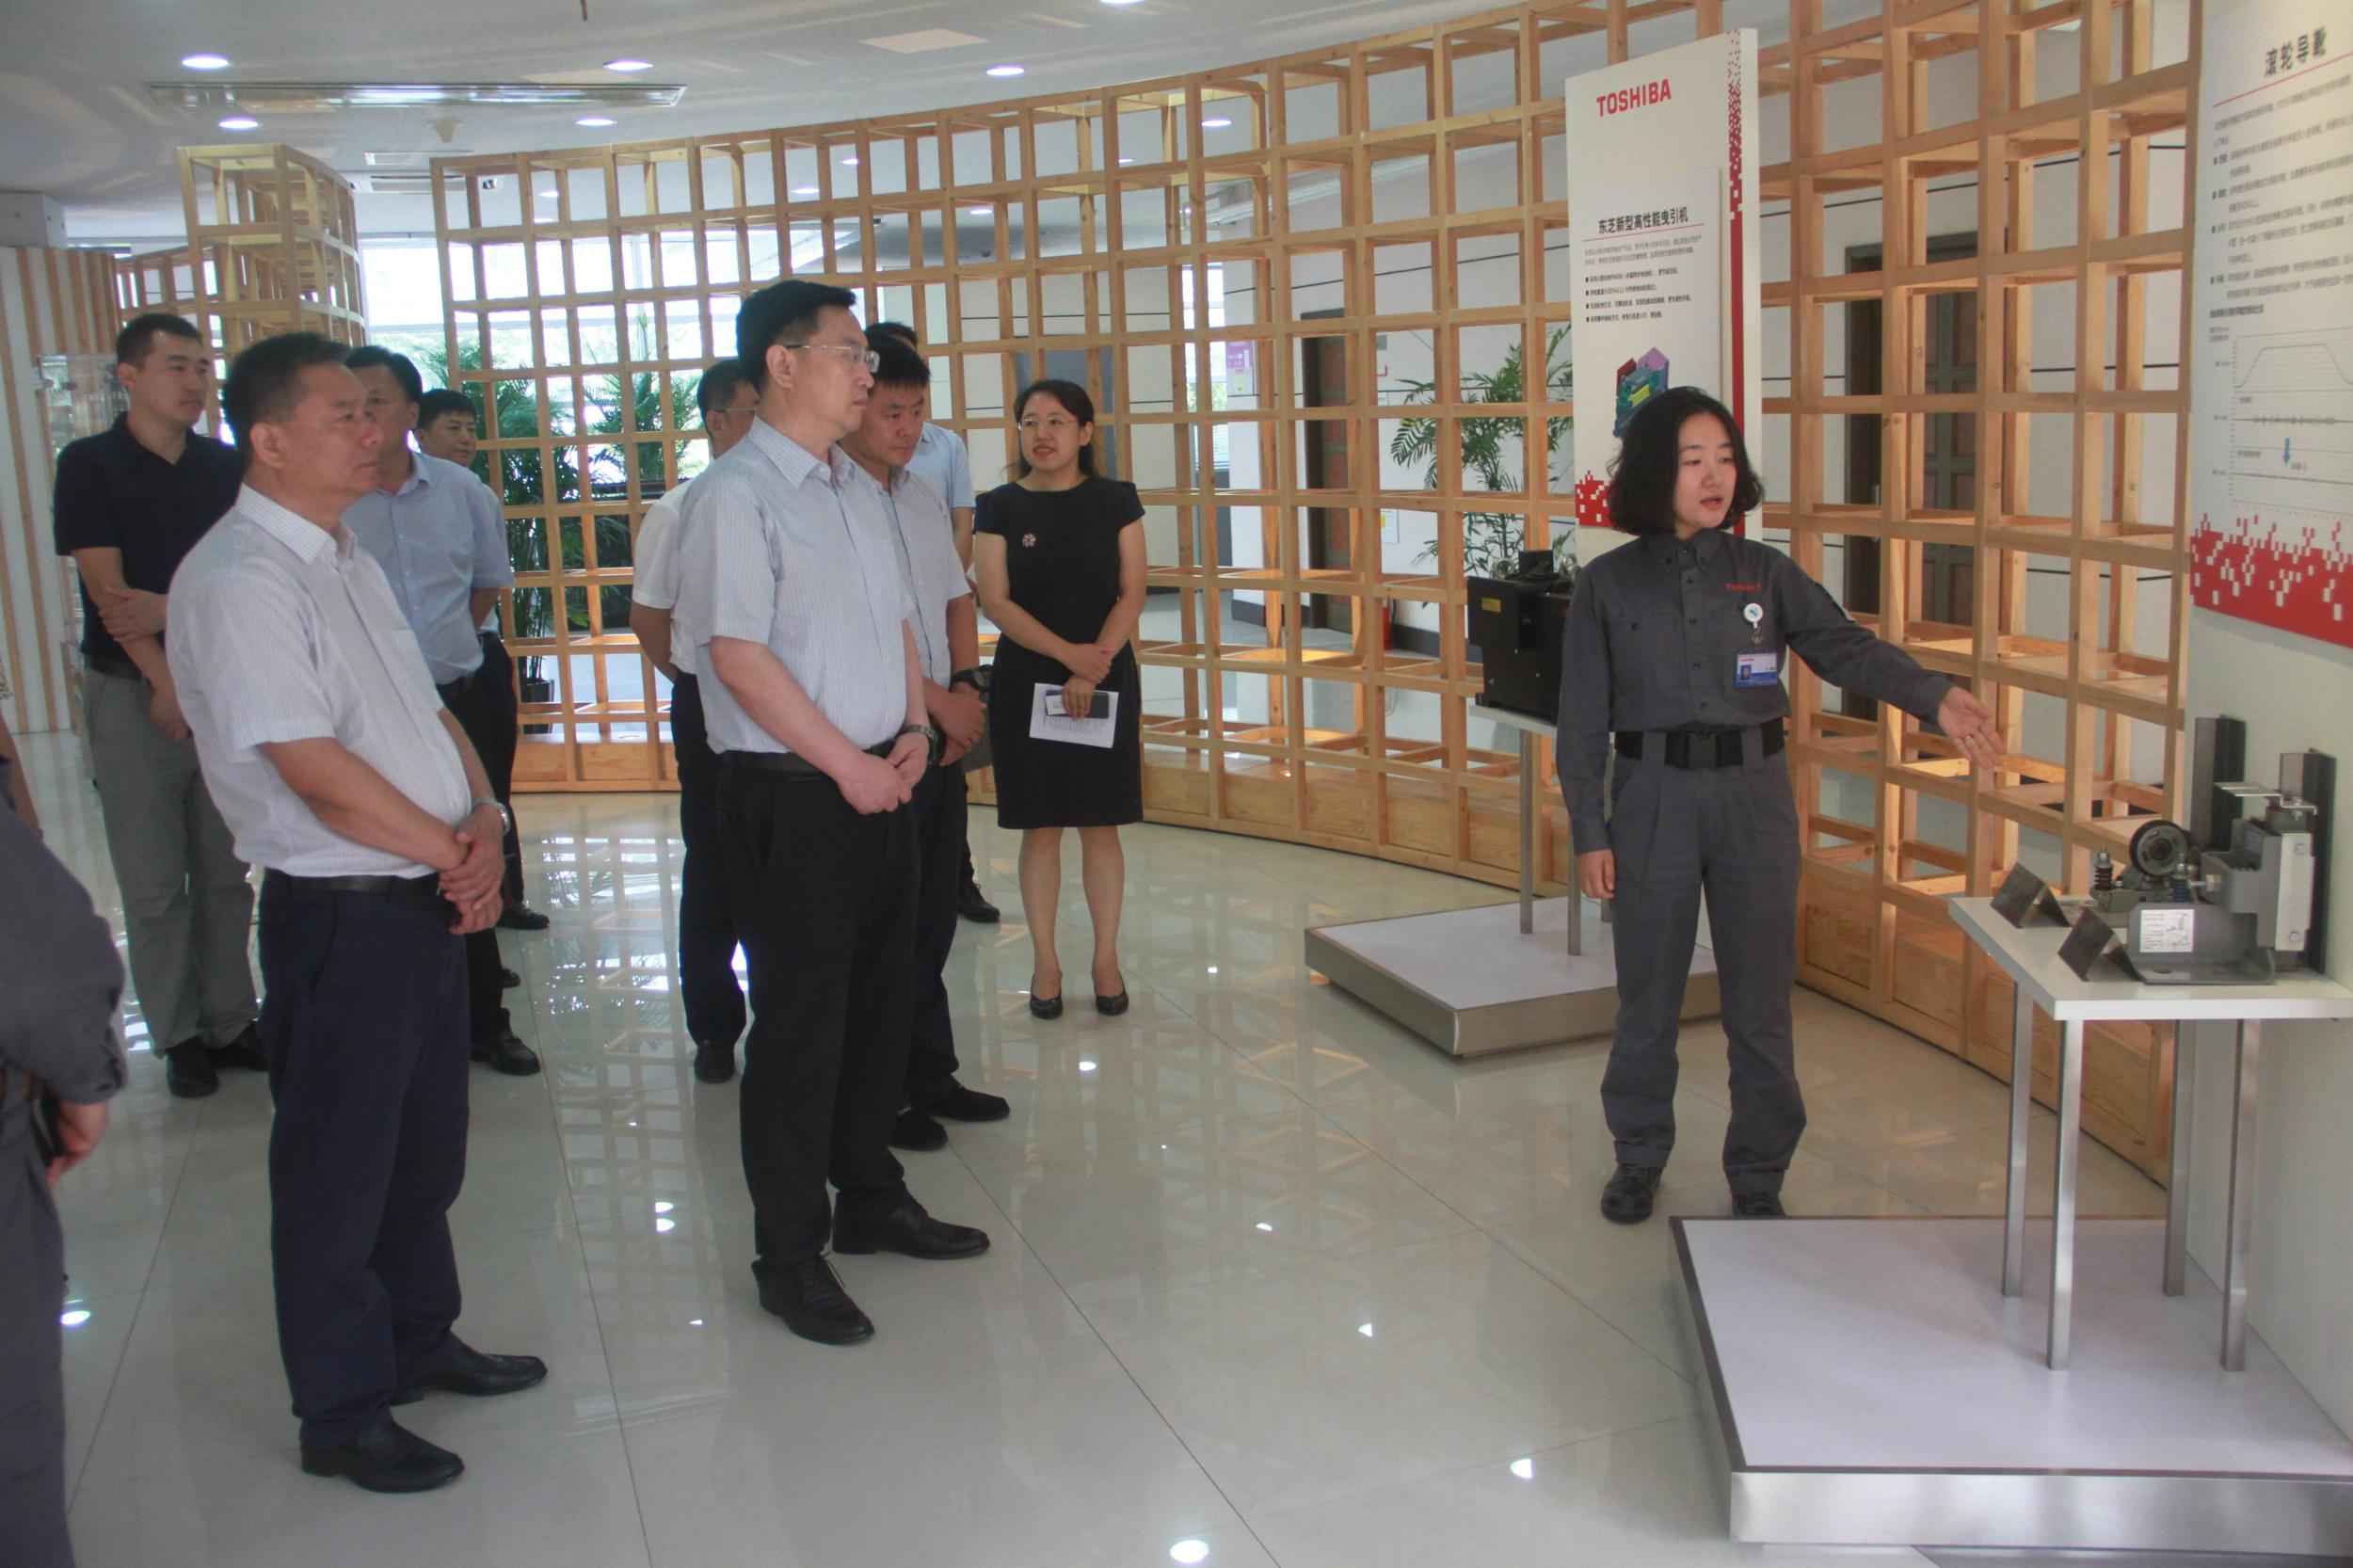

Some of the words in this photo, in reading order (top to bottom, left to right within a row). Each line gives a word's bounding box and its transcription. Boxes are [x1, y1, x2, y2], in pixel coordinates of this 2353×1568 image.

[1596, 78, 1672, 118] TOSHIBA
[1598, 206, 1689, 234] 东芝新型高性能曳引机
